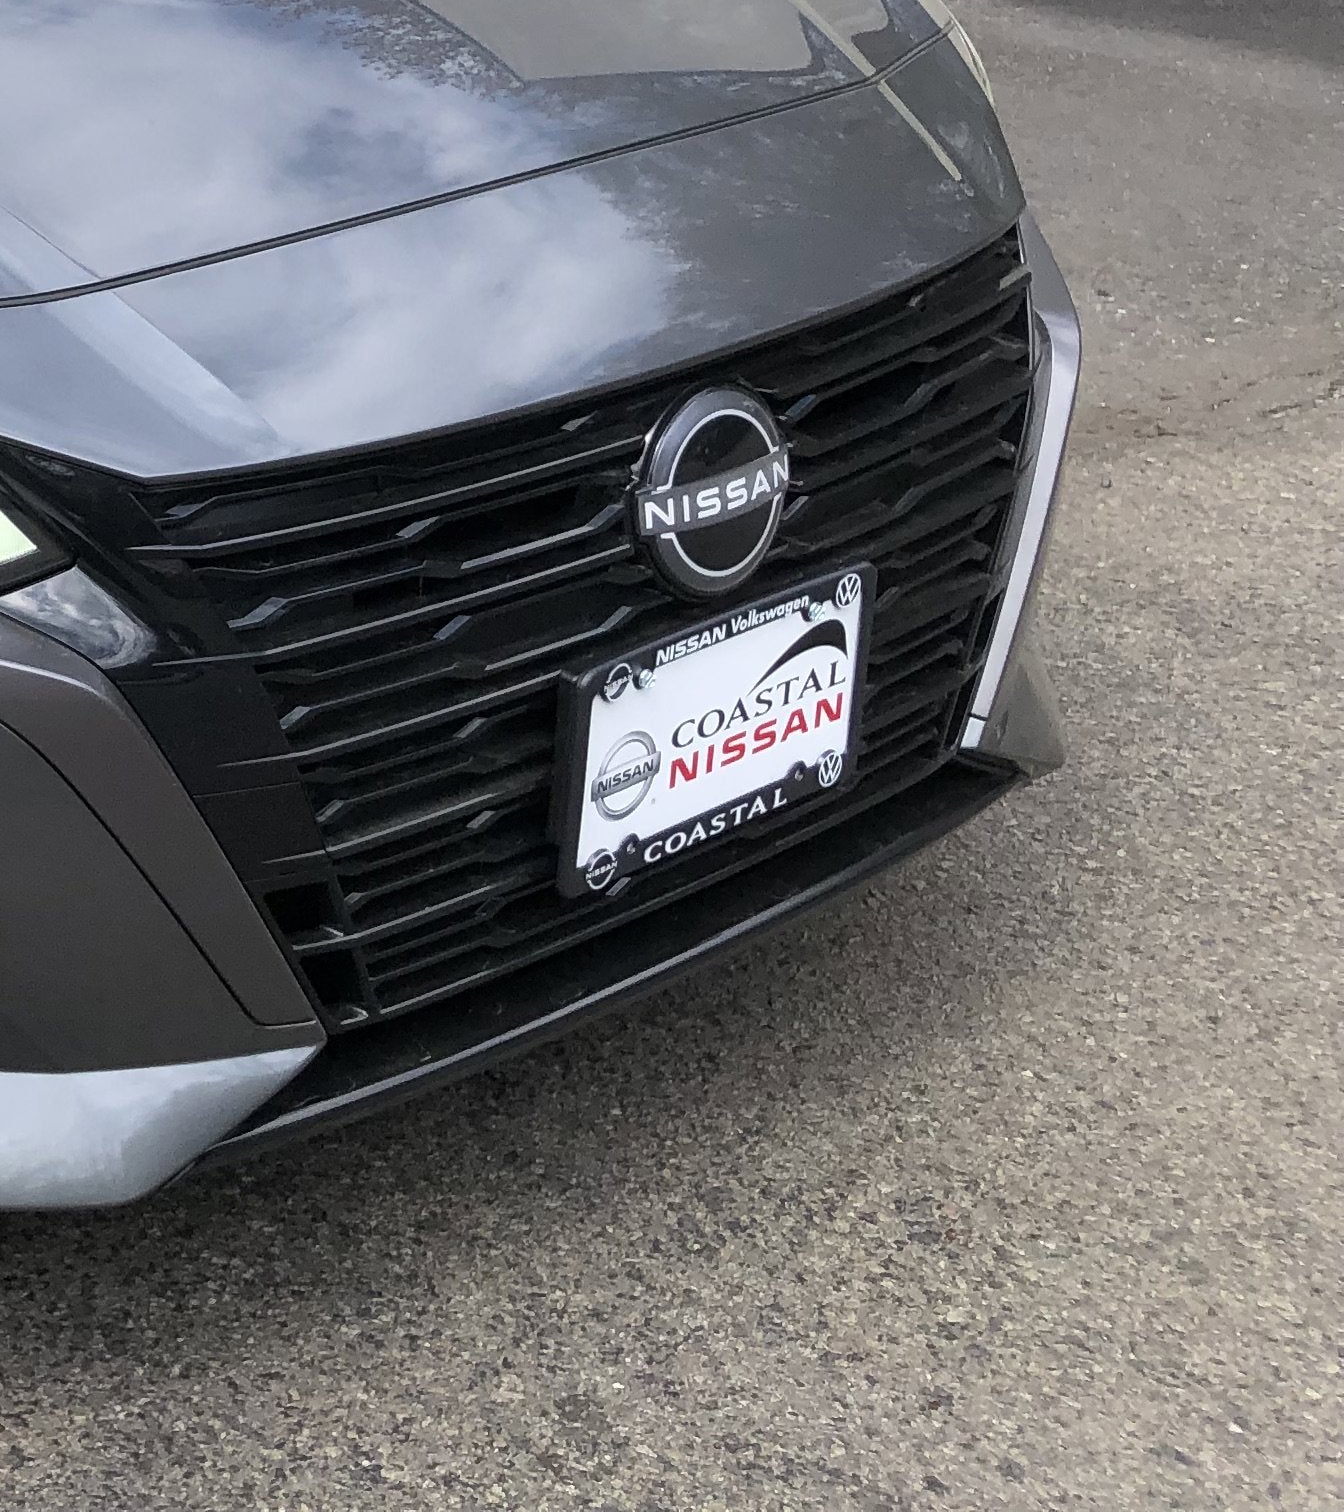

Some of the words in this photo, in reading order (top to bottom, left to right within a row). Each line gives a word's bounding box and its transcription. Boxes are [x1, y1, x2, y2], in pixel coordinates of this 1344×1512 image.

[645, 454, 790, 529] NISSAN
[655, 624, 726, 666] NISSAN
[731, 595, 810, 635] Volkswagen
[669, 692, 843, 789] NISSAN
[671, 660, 846, 749] COASTAL
[597, 758, 655, 794] NISSAN
[644, 788, 788, 863] COASTAL
